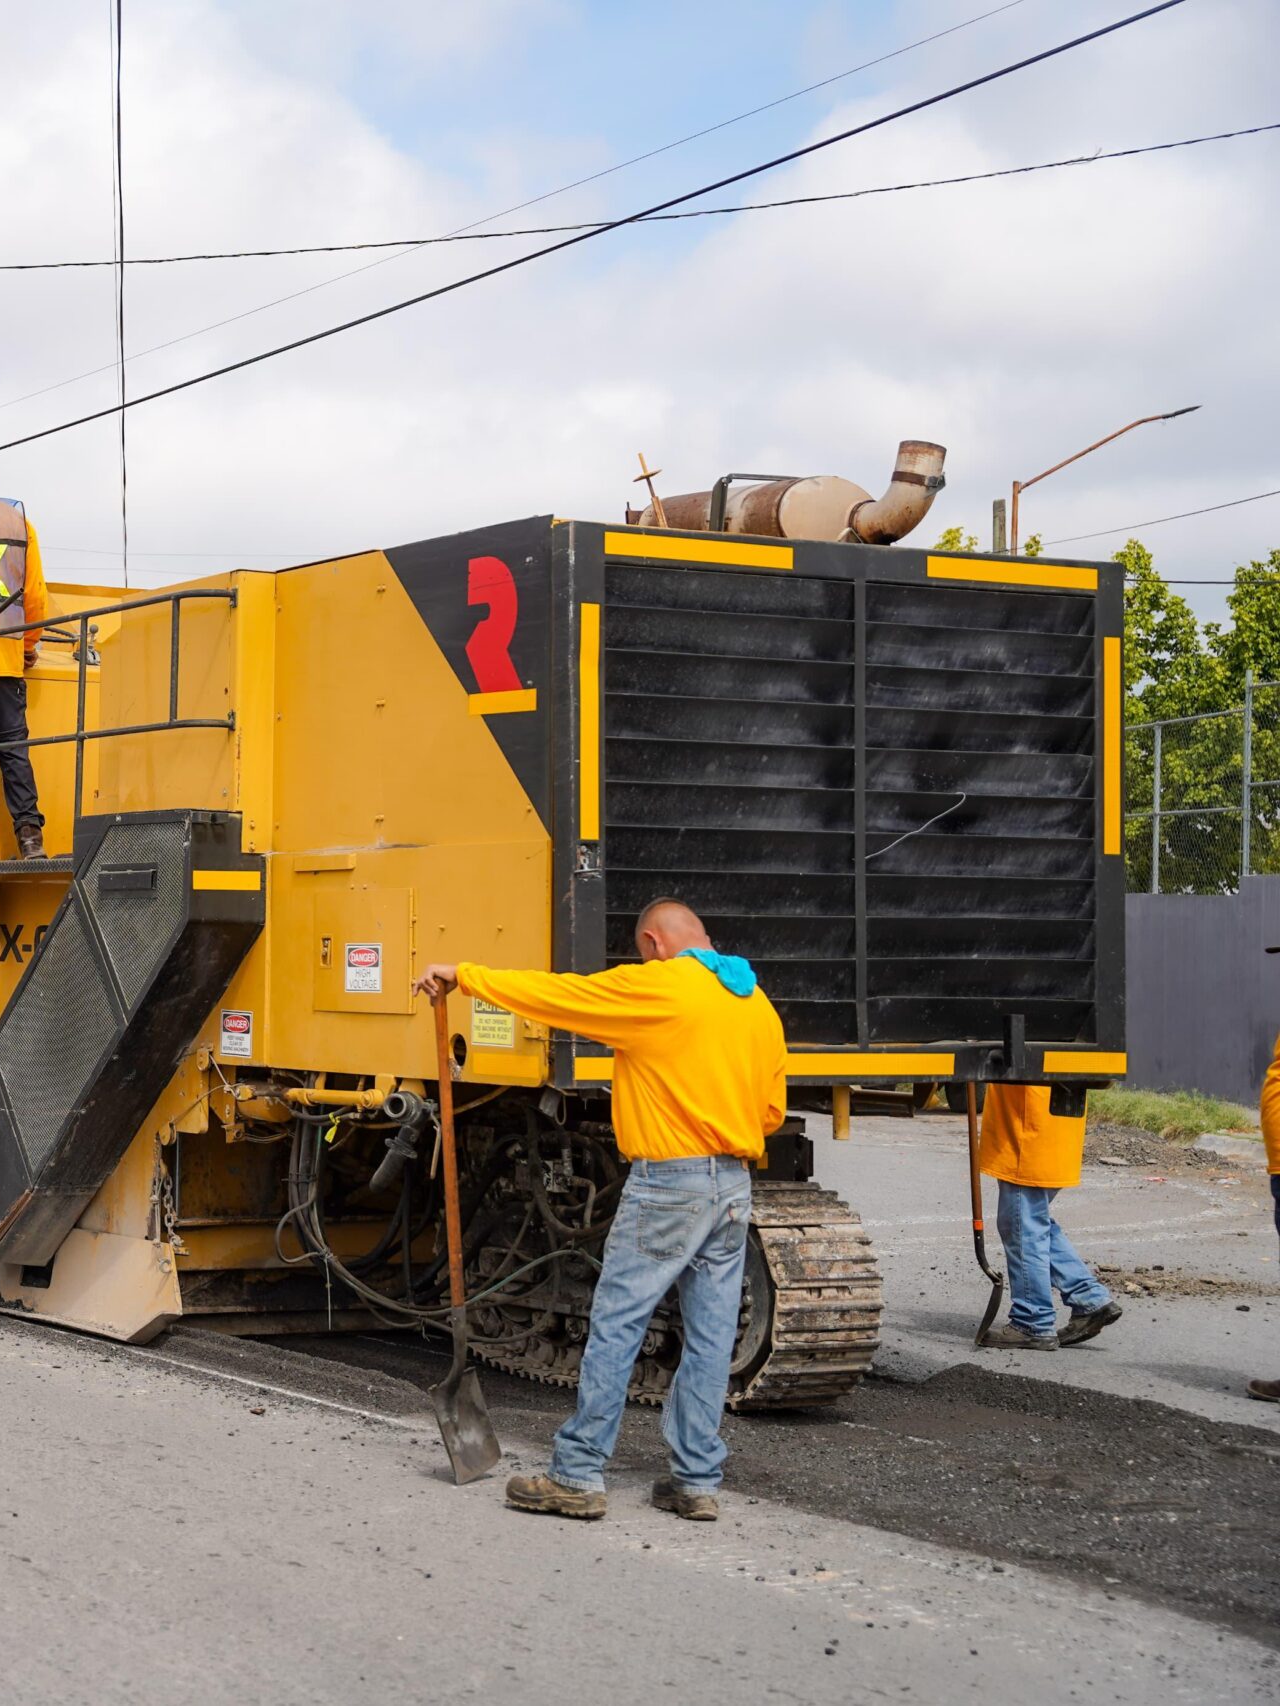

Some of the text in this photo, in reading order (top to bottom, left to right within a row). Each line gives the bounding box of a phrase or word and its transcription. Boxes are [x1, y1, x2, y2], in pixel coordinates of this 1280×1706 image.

[351, 953, 376, 962] DANGER
[356, 969, 371, 977] HIGH
[349, 979, 377, 989] VOLTAGE
[224, 1019, 248, 1029] DANGER
